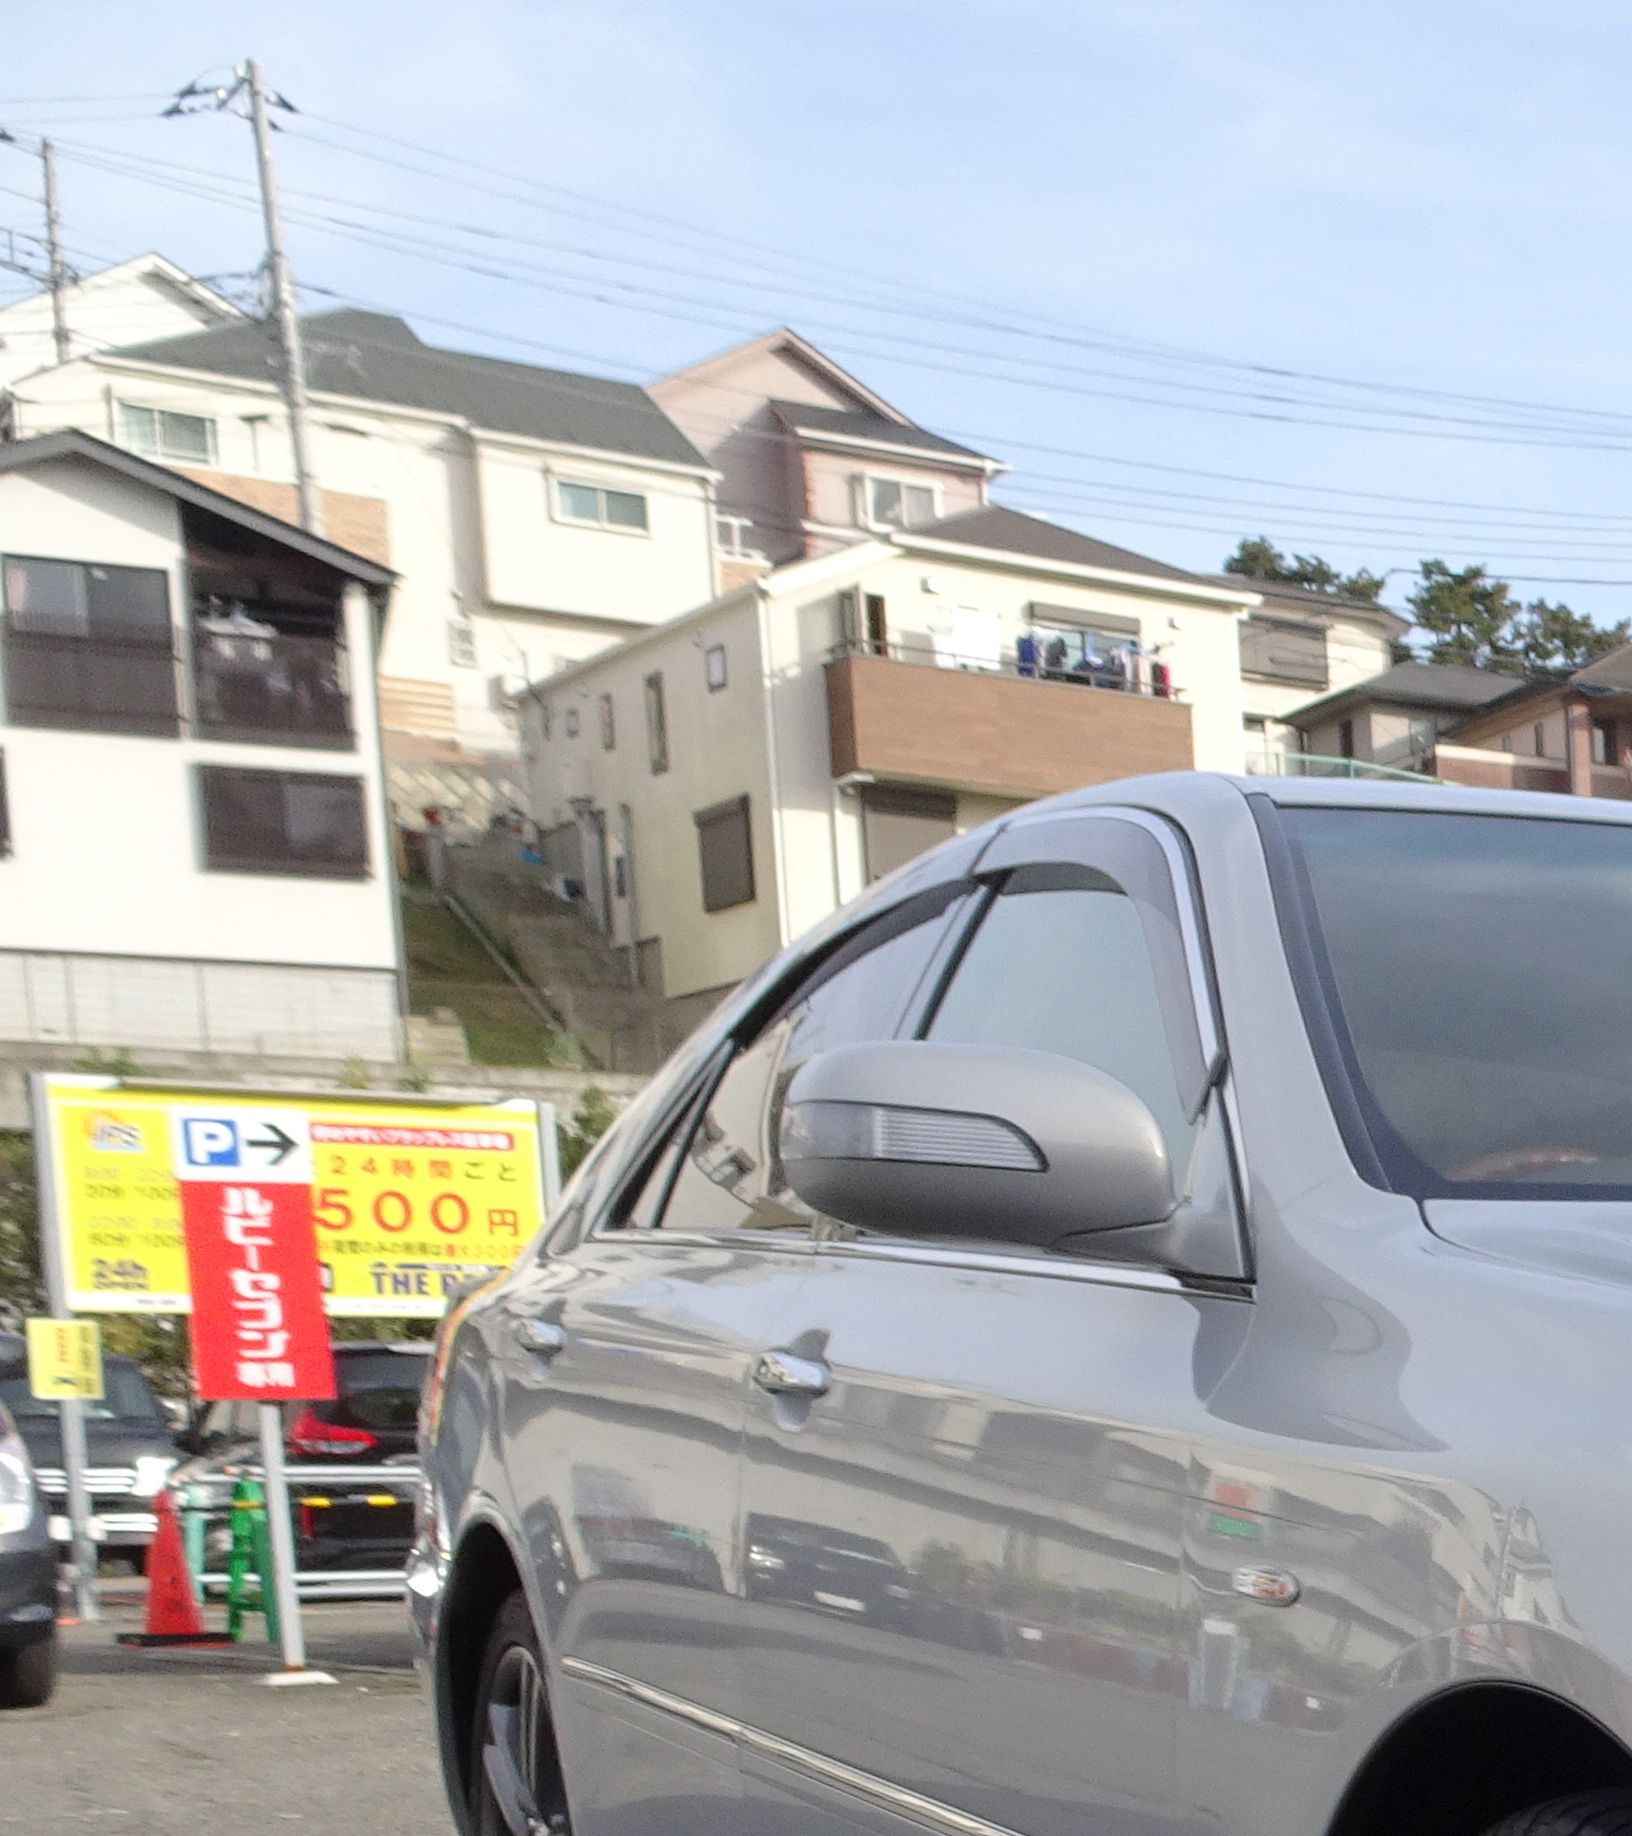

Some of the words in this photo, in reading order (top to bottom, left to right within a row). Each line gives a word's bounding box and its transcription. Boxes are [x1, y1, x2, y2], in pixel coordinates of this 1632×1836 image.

[187, 1120, 235, 1164] P
[313, 1187, 519, 1237] 500円
[369, 1271, 431, 1296] THE
